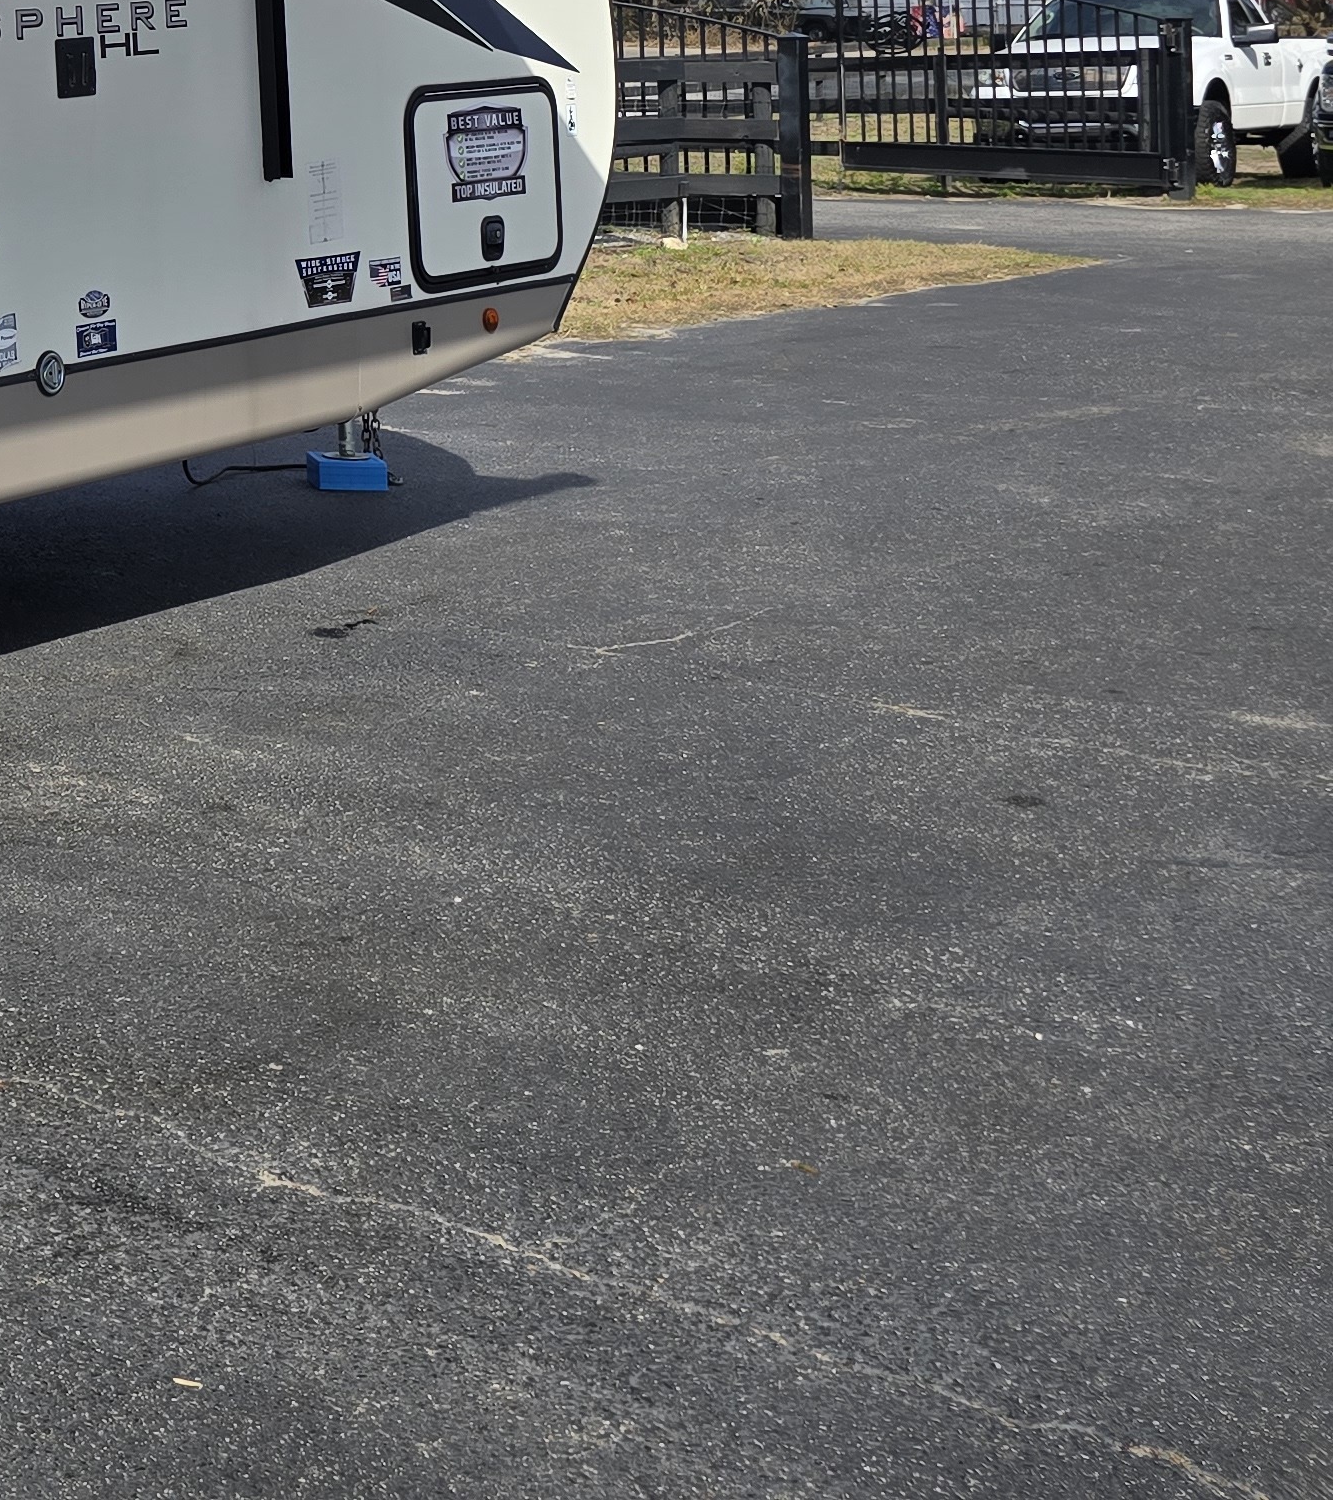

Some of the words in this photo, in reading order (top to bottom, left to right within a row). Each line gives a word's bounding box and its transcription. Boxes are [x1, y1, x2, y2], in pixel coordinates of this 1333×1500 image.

[99, 32, 160, 59] HL
[450, 115, 479, 130] BEST
[484, 112, 520, 127] VALUE
[454, 184, 473, 199] TOP
[474, 179, 523, 196] INSULATED
[302, 262, 354, 277] SUSPENSION
[388, 270, 401, 283] USA
